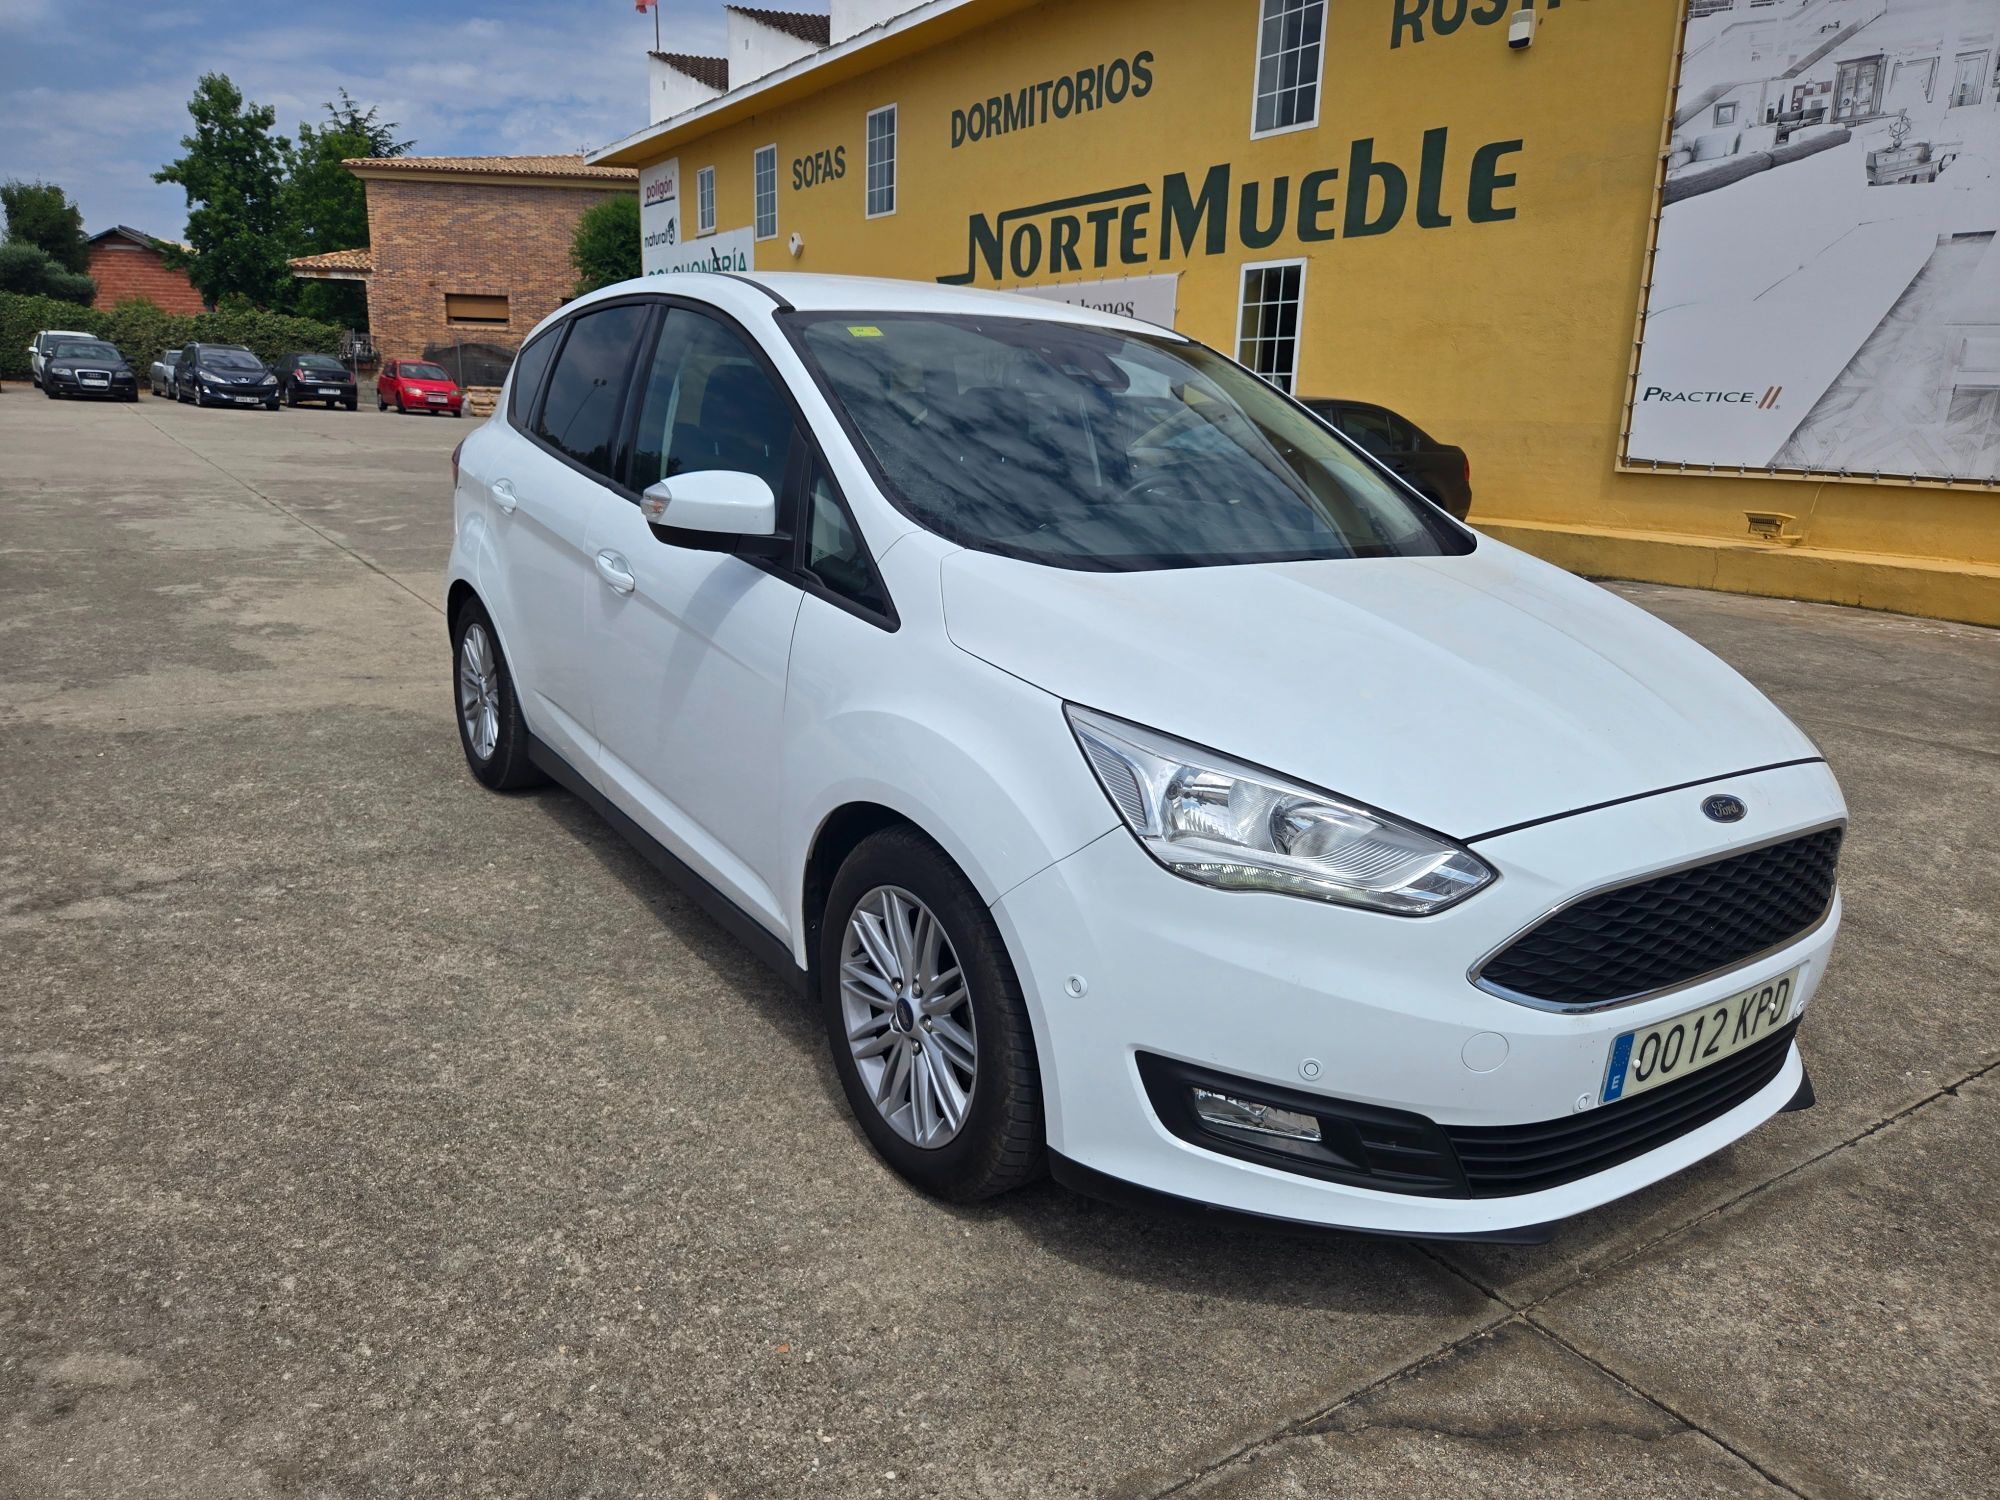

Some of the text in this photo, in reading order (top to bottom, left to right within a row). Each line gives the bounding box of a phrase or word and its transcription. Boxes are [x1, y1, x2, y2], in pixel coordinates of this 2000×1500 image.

[951, 50, 1154, 149] DORMITORIOS
[793, 145, 846, 191] SOFAS
[1643, 386, 1755, 403] PRACTICE
[1711, 799, 1739, 818] Ford
[1635, 977, 1790, 1082] 0012 KPD
[1611, 1074, 1620, 1090] E
